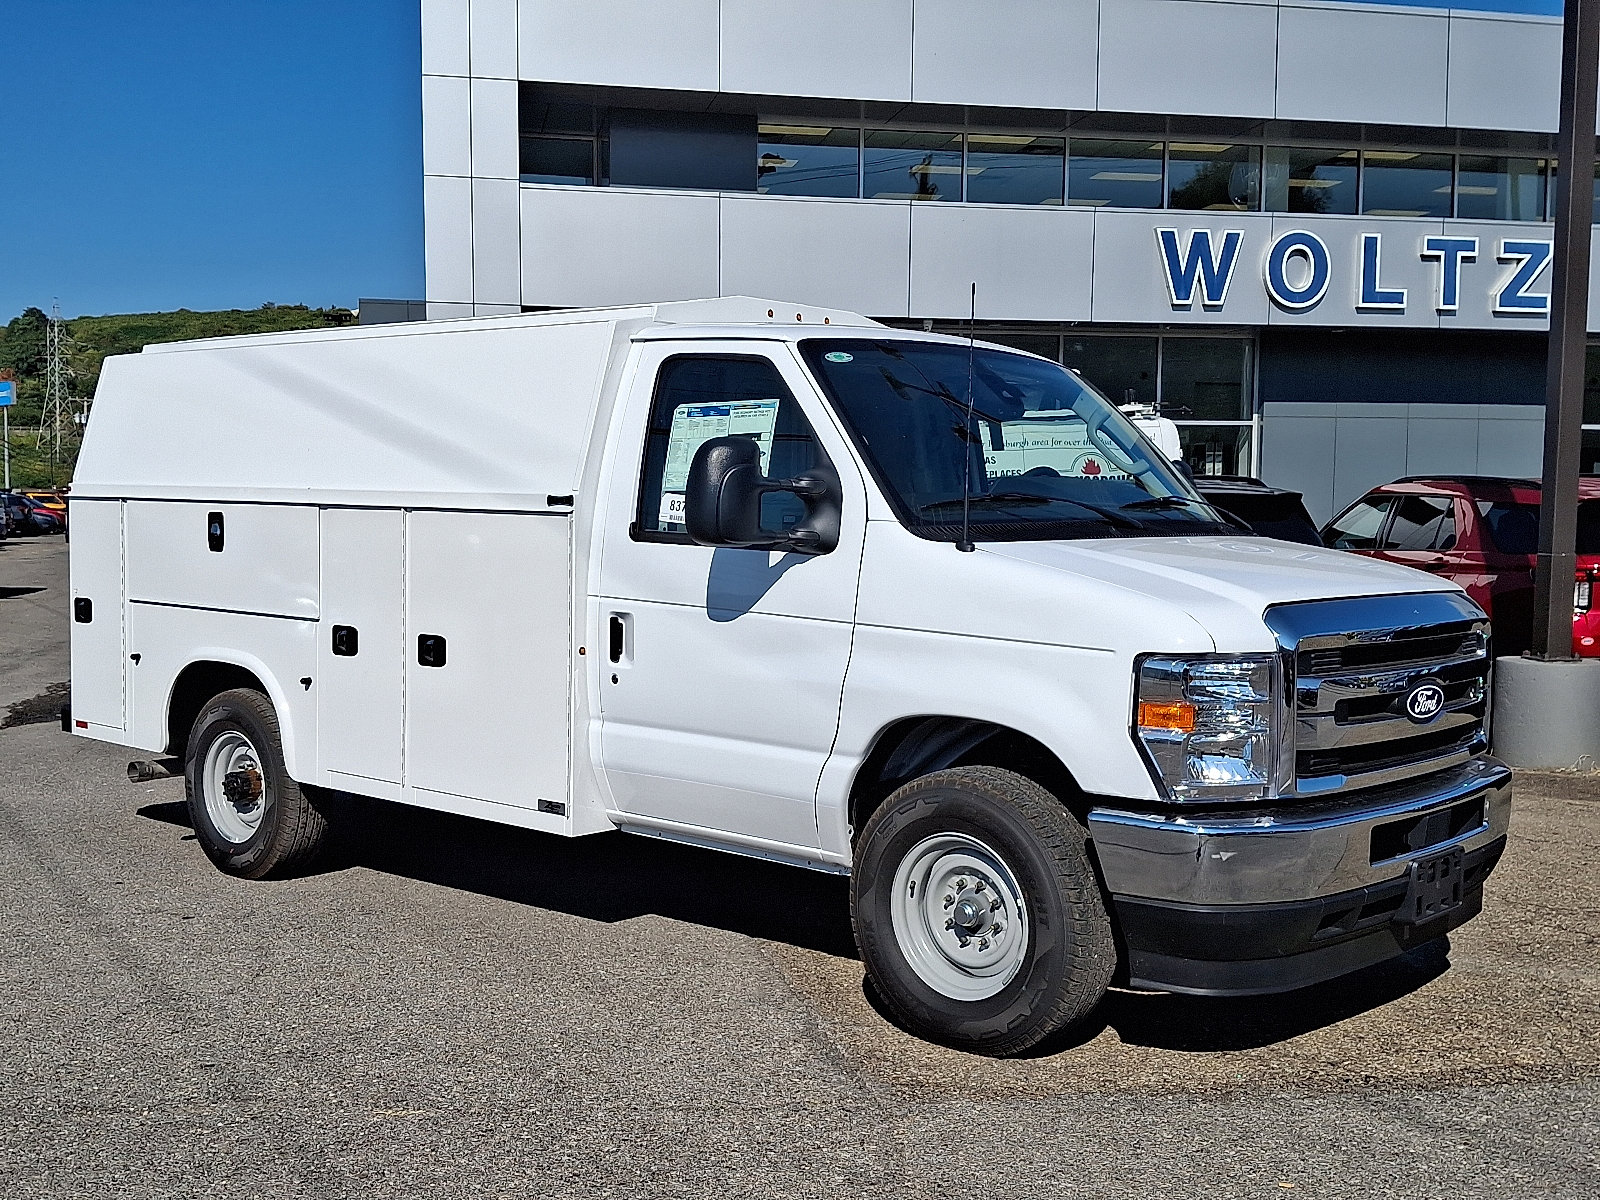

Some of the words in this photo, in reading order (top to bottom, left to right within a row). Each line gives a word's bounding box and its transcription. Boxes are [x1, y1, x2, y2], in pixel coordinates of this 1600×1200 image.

[1155, 226, 1553, 316] WOLTZ
[1051, 437, 1062, 447] for
[1414, 689, 1439, 713] Ford
